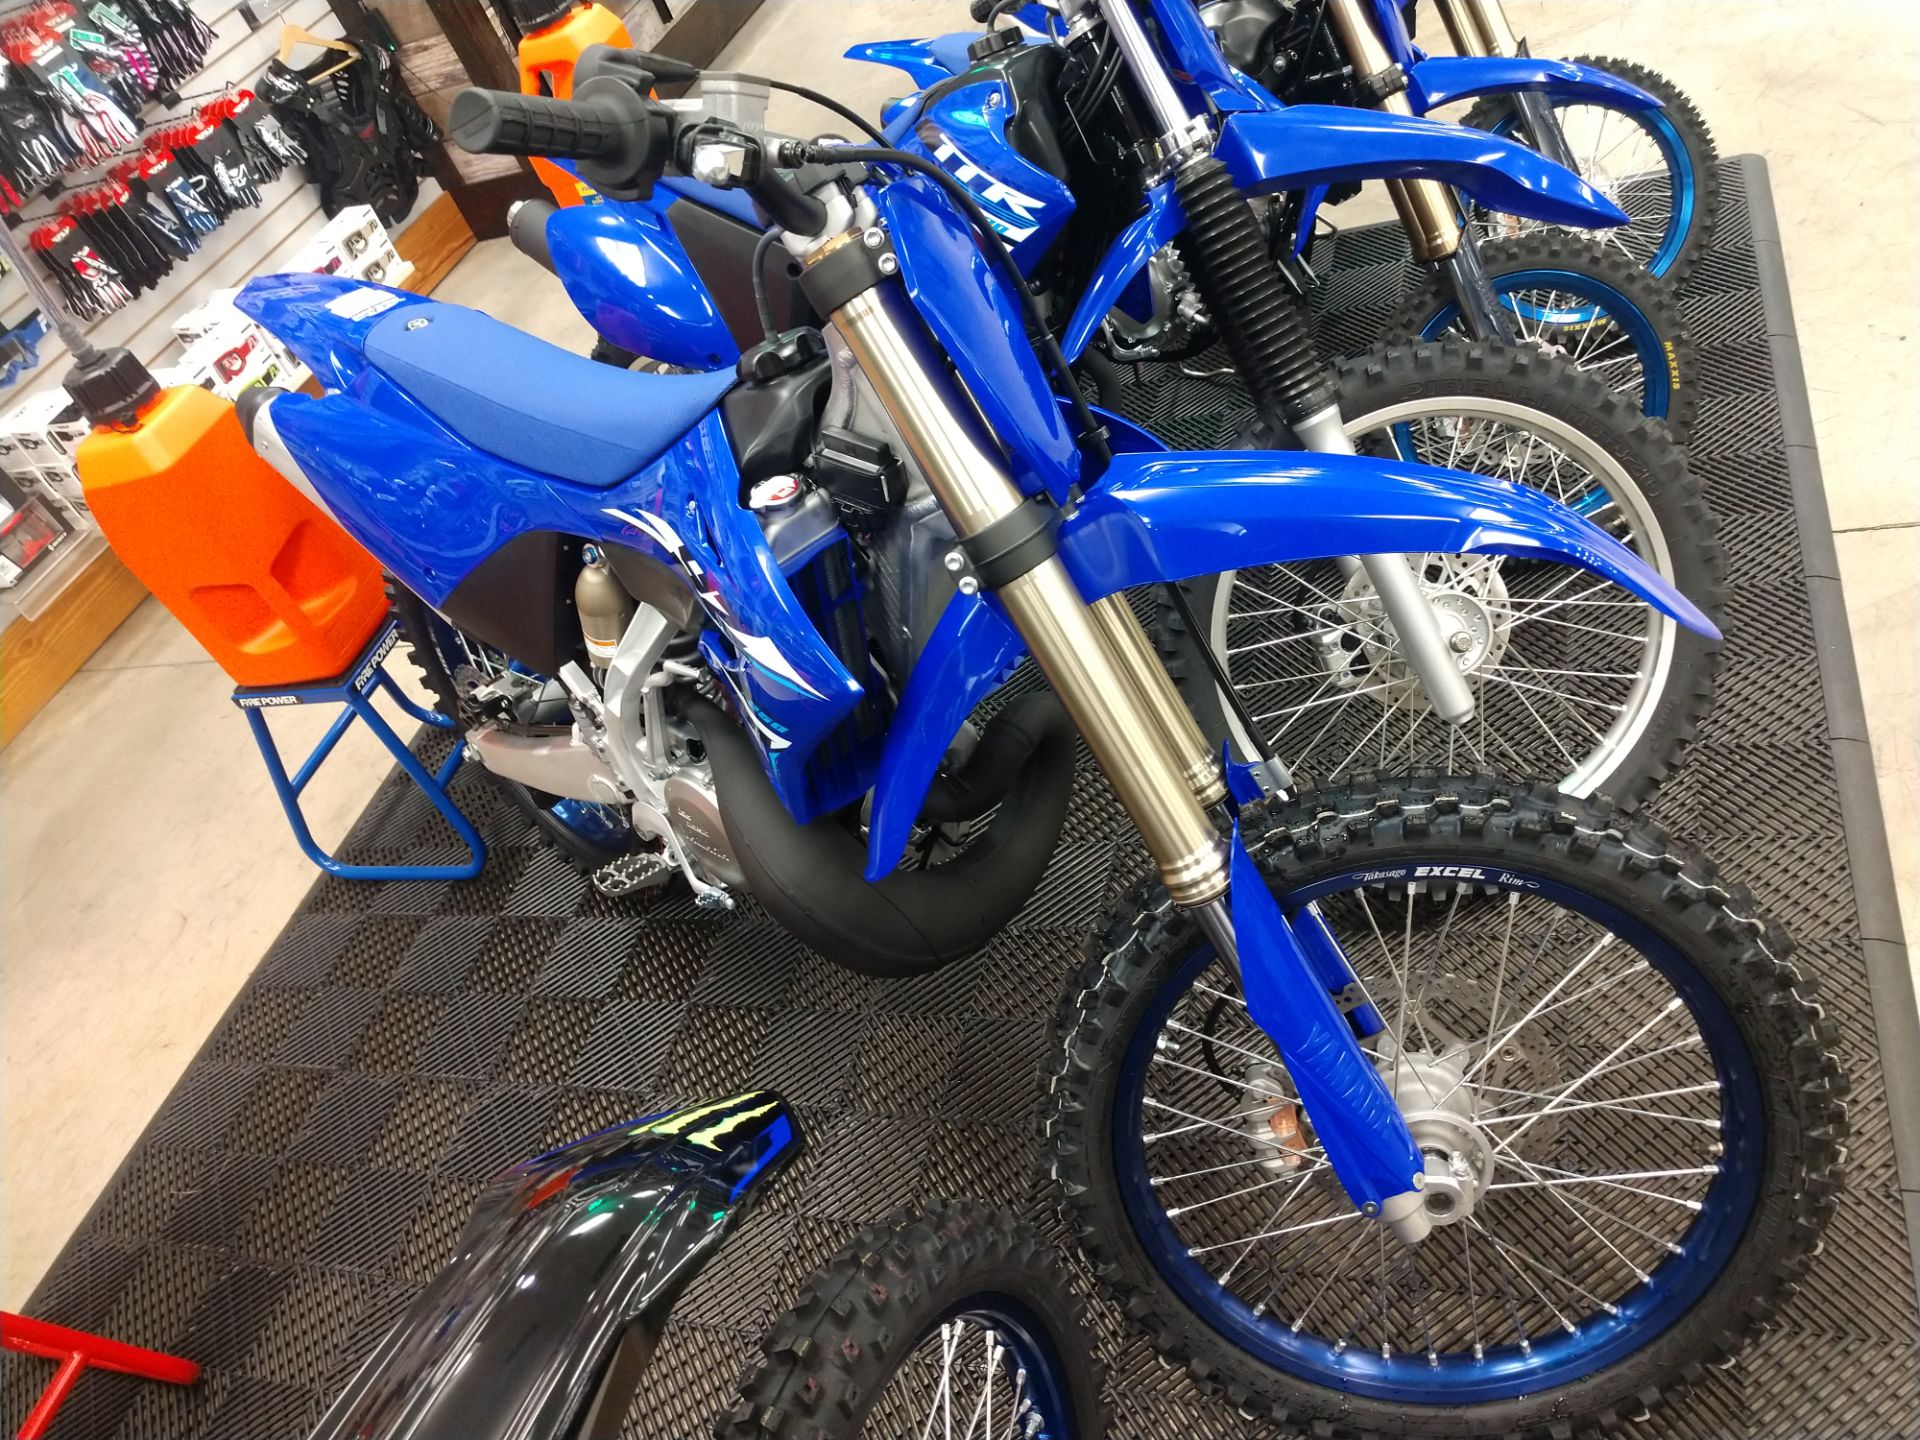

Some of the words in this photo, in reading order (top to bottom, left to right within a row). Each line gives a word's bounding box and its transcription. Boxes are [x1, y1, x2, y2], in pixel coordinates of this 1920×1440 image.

[1563, 318, 1607, 332] MAXXIS
[1664, 341, 1680, 390] MAXXIS
[372, 629, 399, 669] POWER
[1362, 868, 1407, 882] Takasago
[1414, 866, 1486, 880] EXCEL
[1499, 873, 1525, 887] Rim
